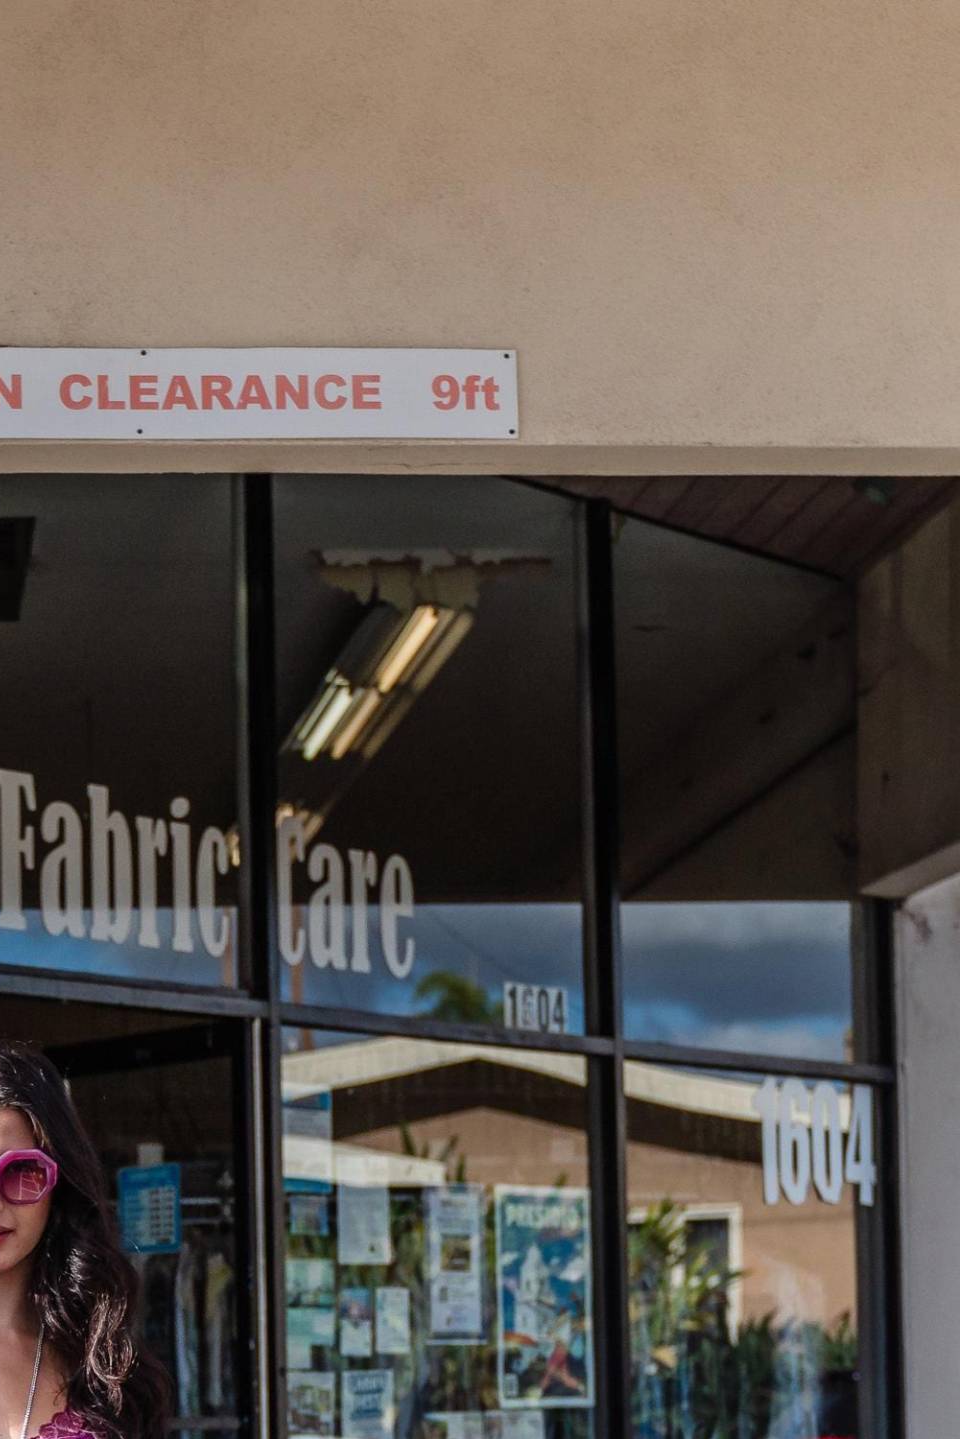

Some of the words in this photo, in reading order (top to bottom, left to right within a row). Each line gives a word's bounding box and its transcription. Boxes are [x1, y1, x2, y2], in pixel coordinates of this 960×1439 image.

[59, 374, 382, 412] CLEARANCE
[431, 375, 500, 412] 9ft
[276, 815, 416, 979] Care
[508, 986, 565, 1032] 1604
[752, 1075, 877, 1207] 1604
